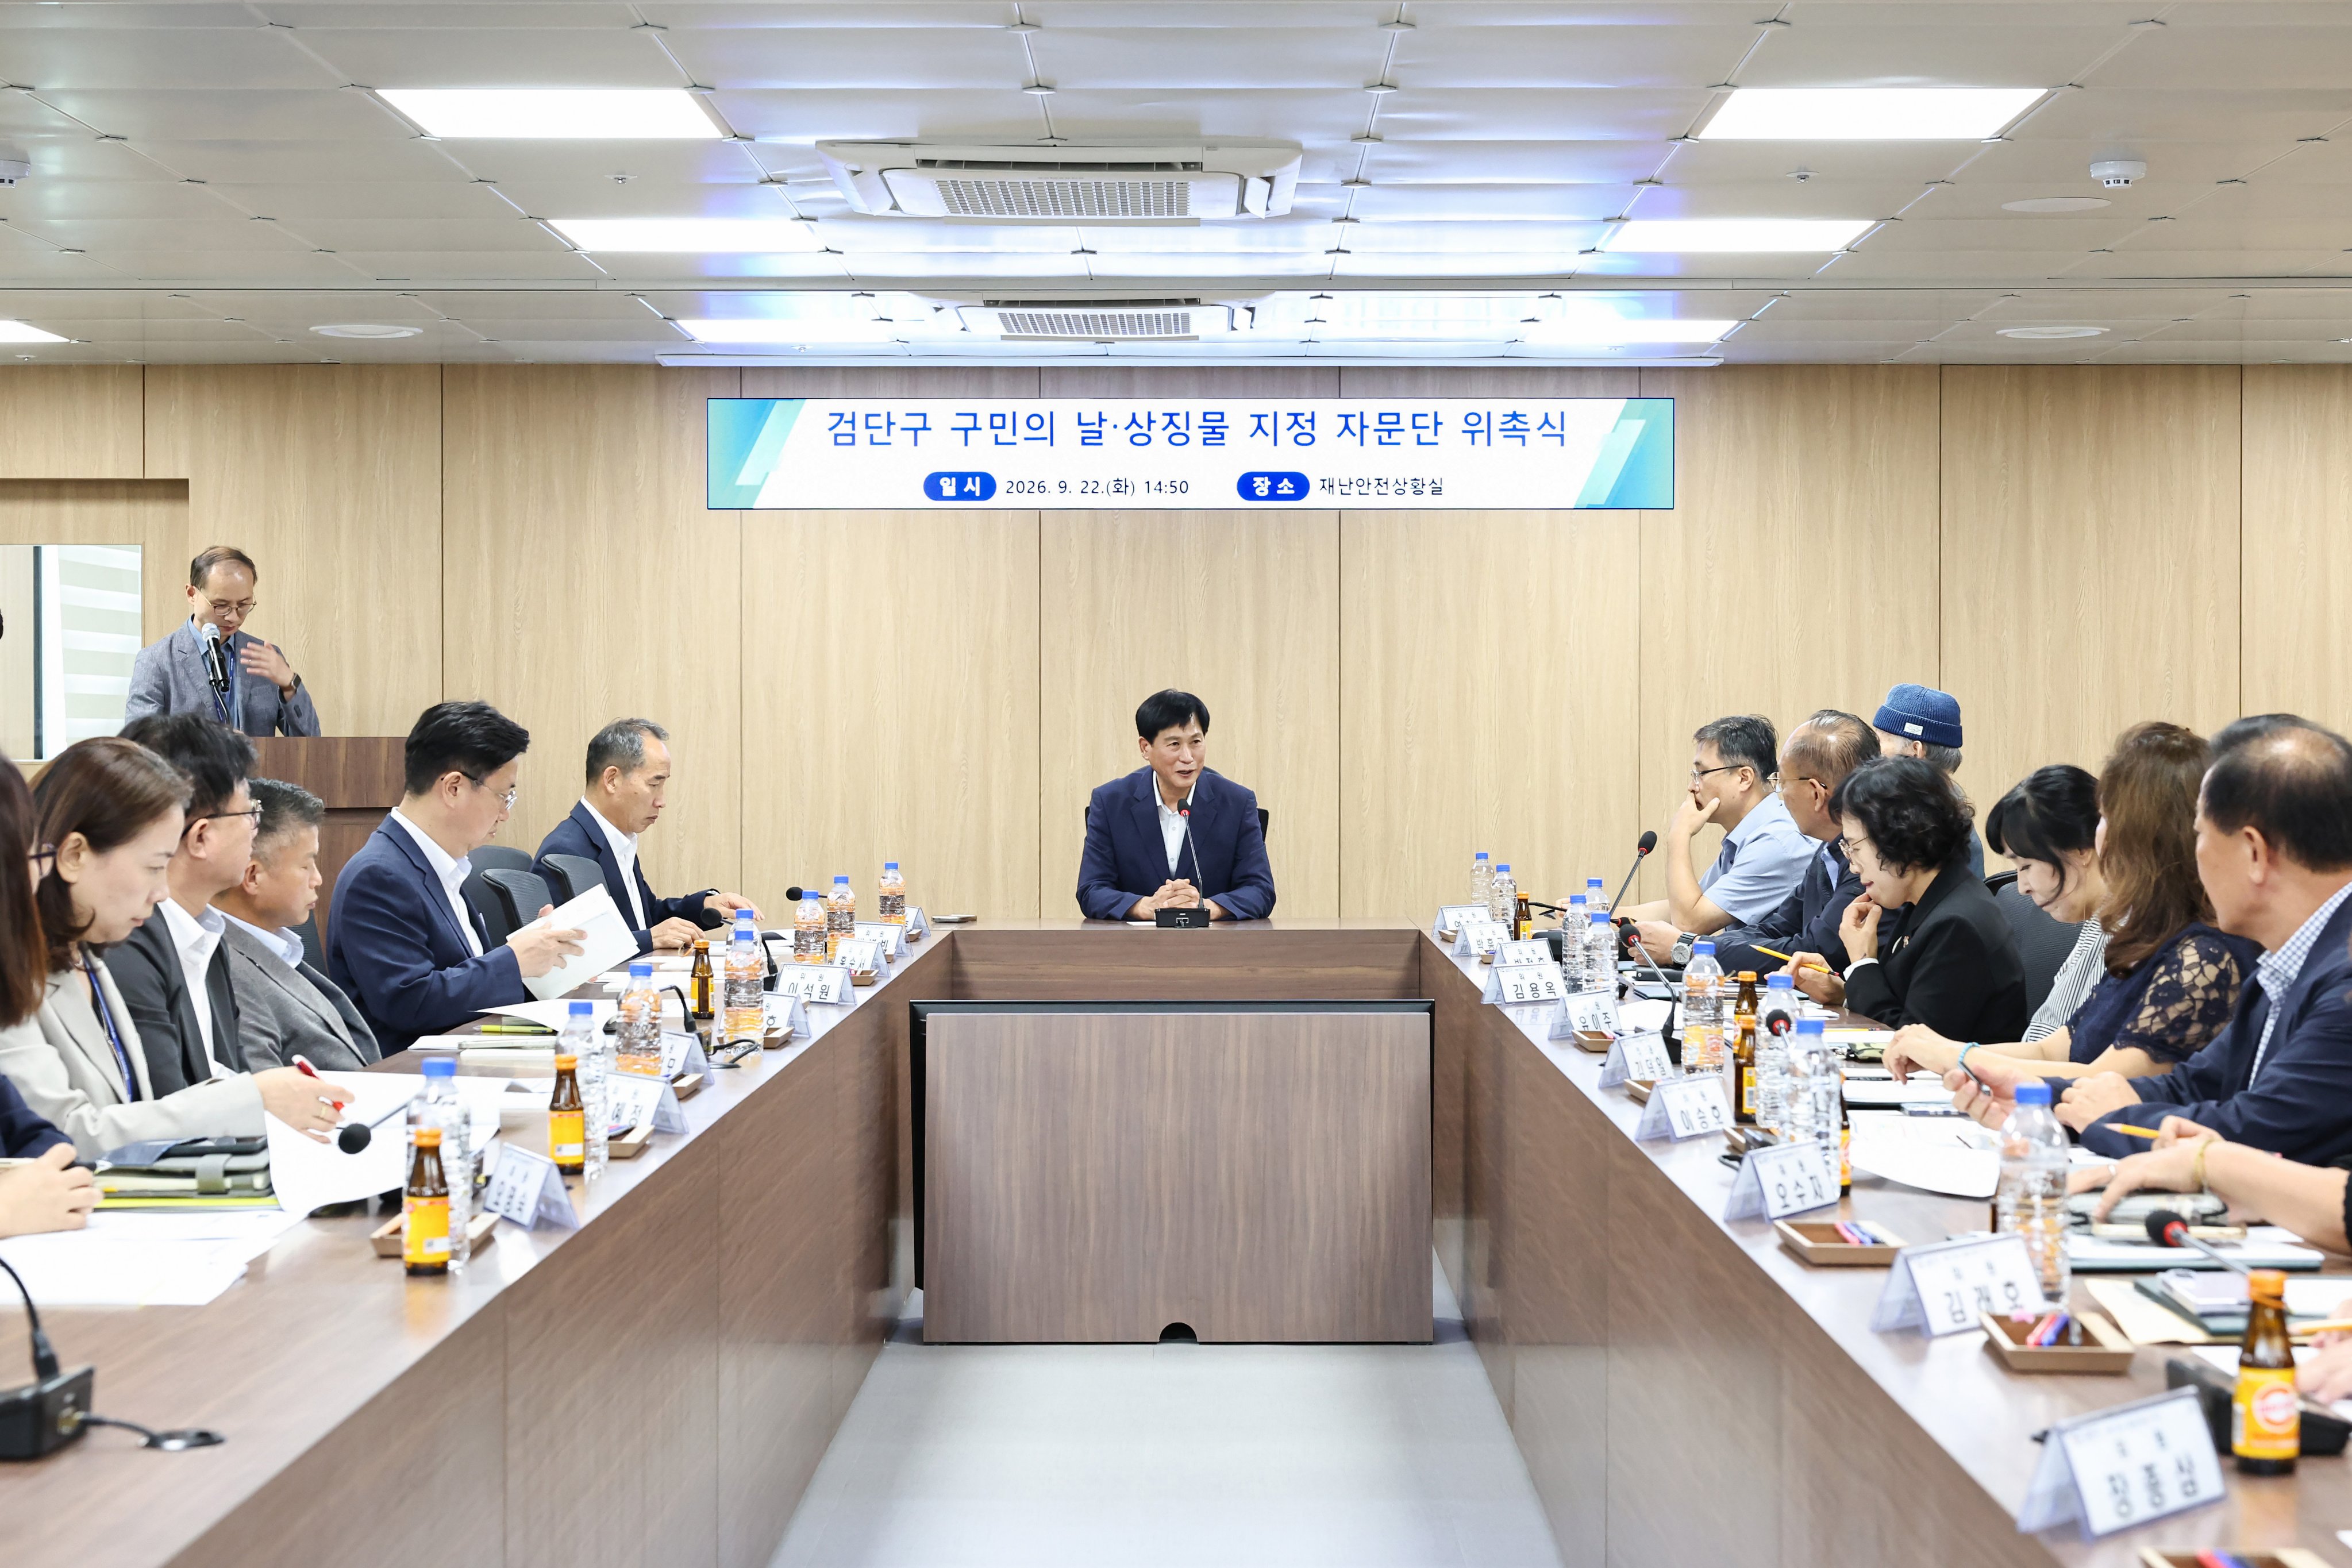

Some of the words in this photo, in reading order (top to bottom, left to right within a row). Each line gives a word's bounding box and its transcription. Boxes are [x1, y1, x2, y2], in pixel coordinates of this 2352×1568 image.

[827, 411, 932, 447] 검단구
[950, 411, 1054, 447] 구민의
[1249, 411, 1315, 447] 지정
[1337, 411, 1443, 447] 자문단
[1461, 410, 1564, 447] 위촉식
[1006, 480, 1050, 494] 2026.
[1058, 480, 1072, 494] 9.
[1080, 477, 1135, 496] 22.(화)
[1145, 480, 1188, 494] 14:50
[1319, 477, 1442, 495] 재난안전상황실
[1513, 981, 1556, 999] 김용옥
